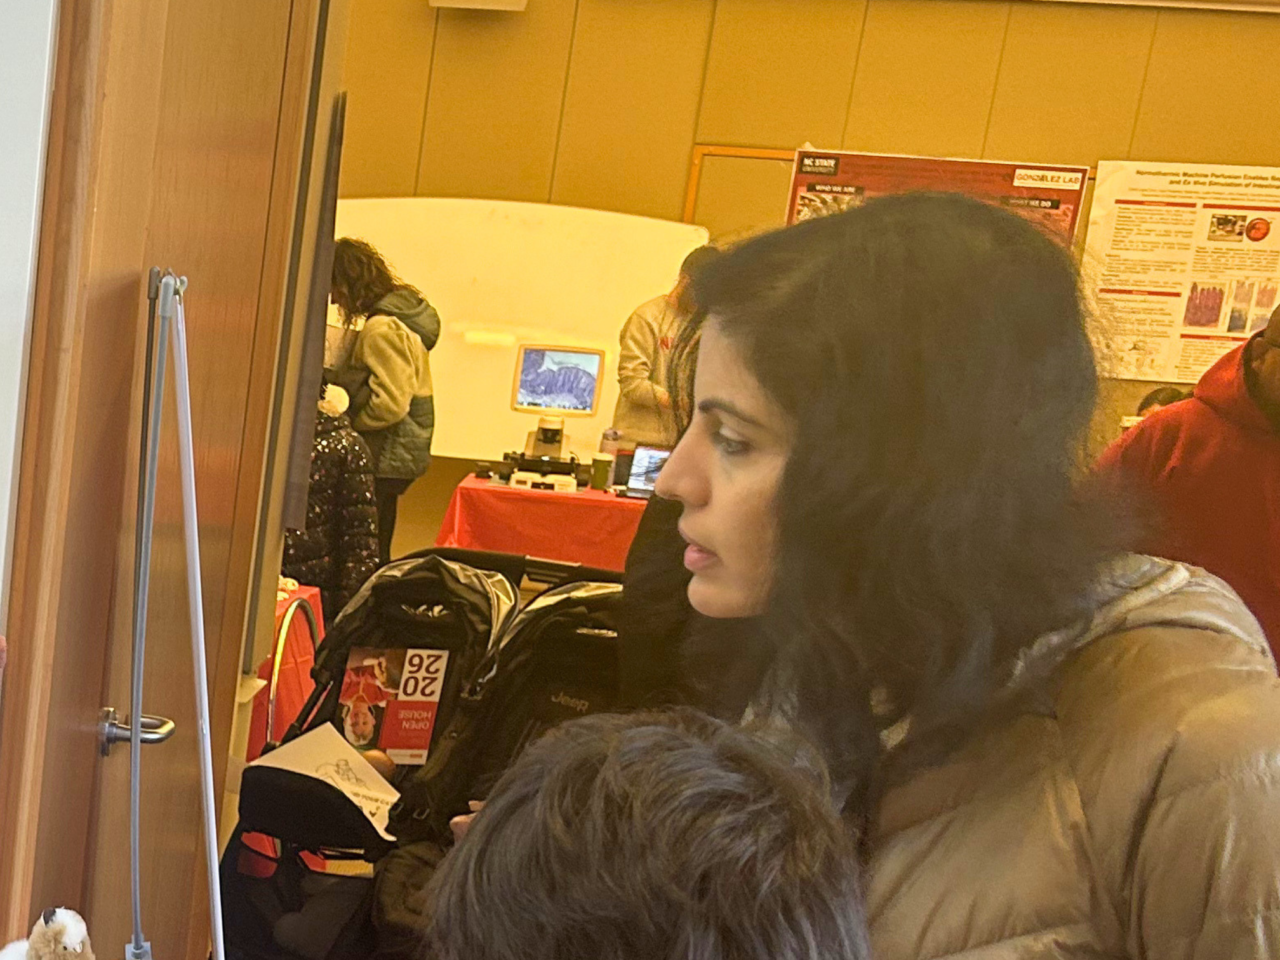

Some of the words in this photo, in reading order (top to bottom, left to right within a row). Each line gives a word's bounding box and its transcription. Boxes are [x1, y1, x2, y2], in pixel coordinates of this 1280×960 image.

[1063, 177, 1080, 185] LAB
[408, 654, 442, 674] 26
[402, 676, 438, 697] 20
[398, 710, 432, 719] HOUSE
[402, 721, 429, 730] OPEN
